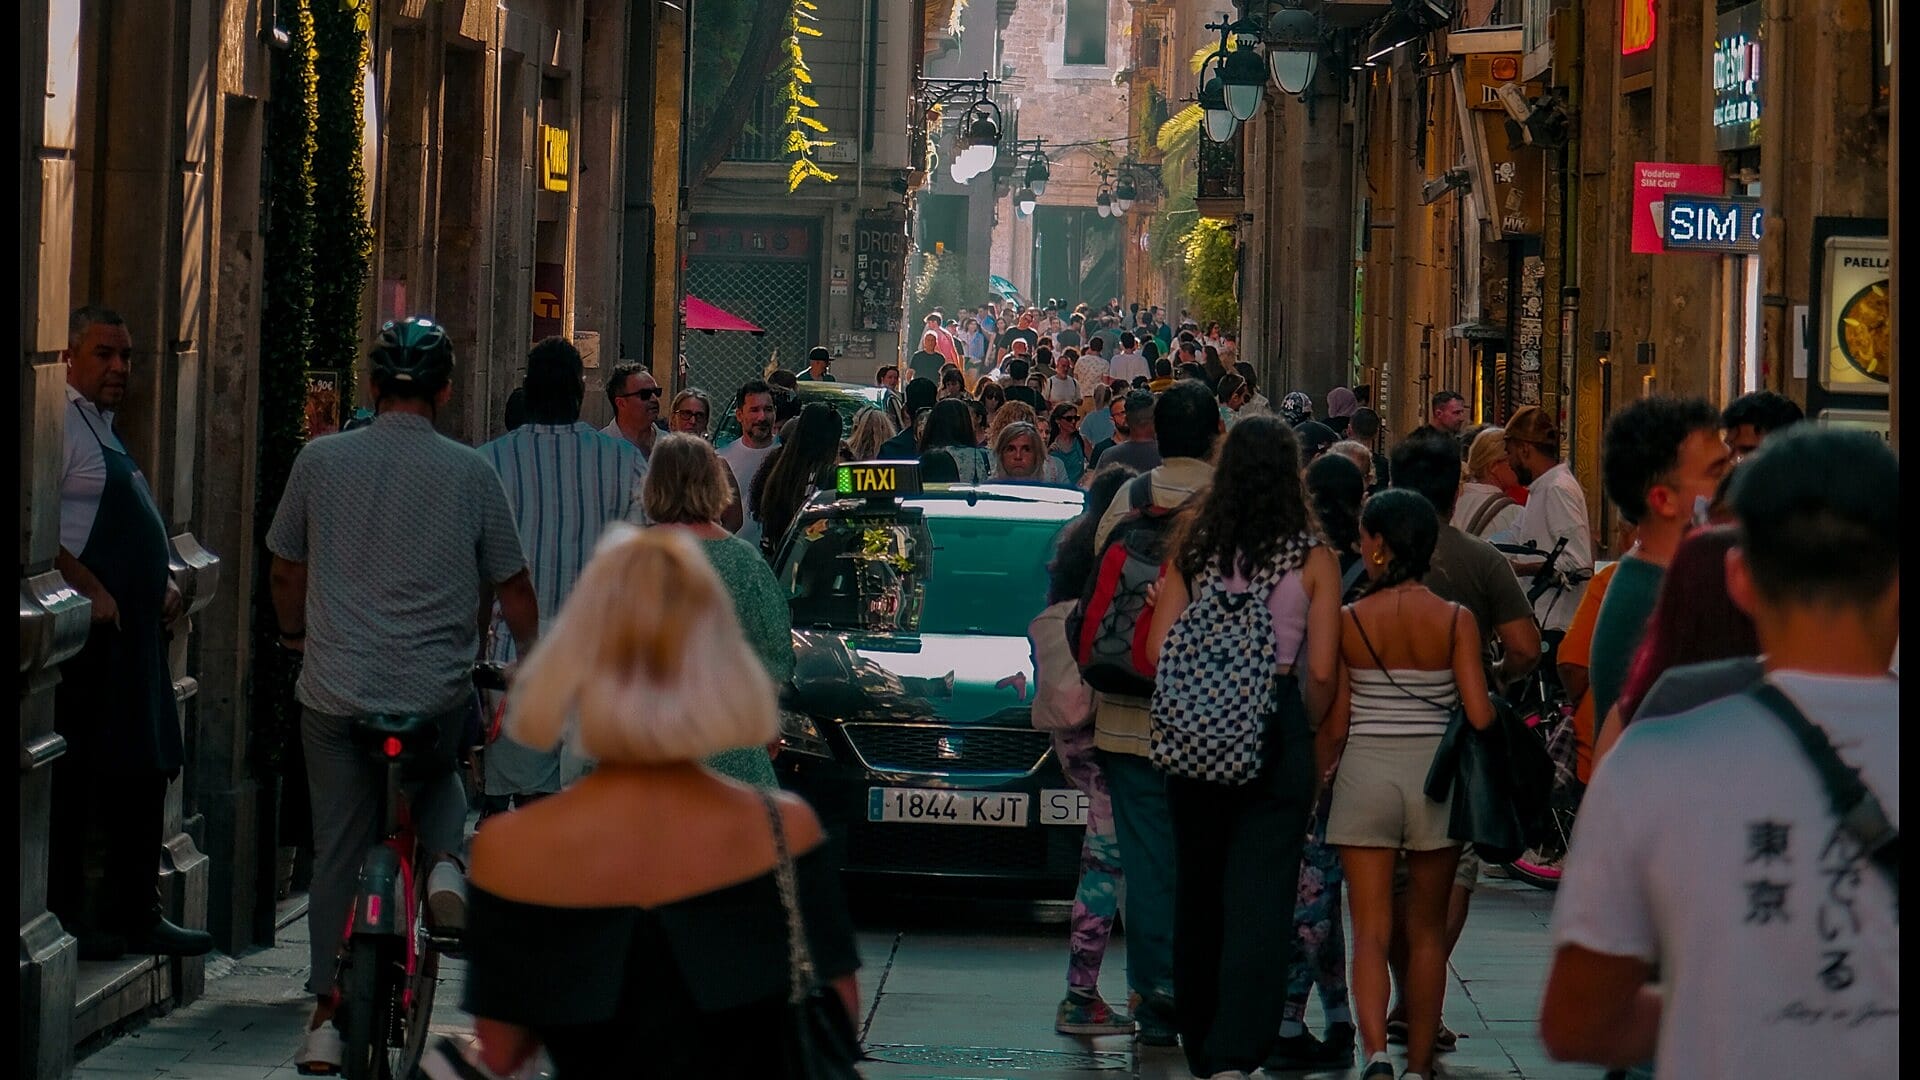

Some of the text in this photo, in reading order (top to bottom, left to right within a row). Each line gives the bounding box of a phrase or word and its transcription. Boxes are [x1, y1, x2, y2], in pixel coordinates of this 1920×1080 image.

[1641, 169, 1680, 179] Vodafone
[1641, 179, 1676, 188] SIM Card
[1671, 207, 1737, 241] SIM
[853, 468, 896, 491] TAXI
[896, 793, 1022, 822] 1844 KJT
[1744, 819, 1791, 925] 東京
